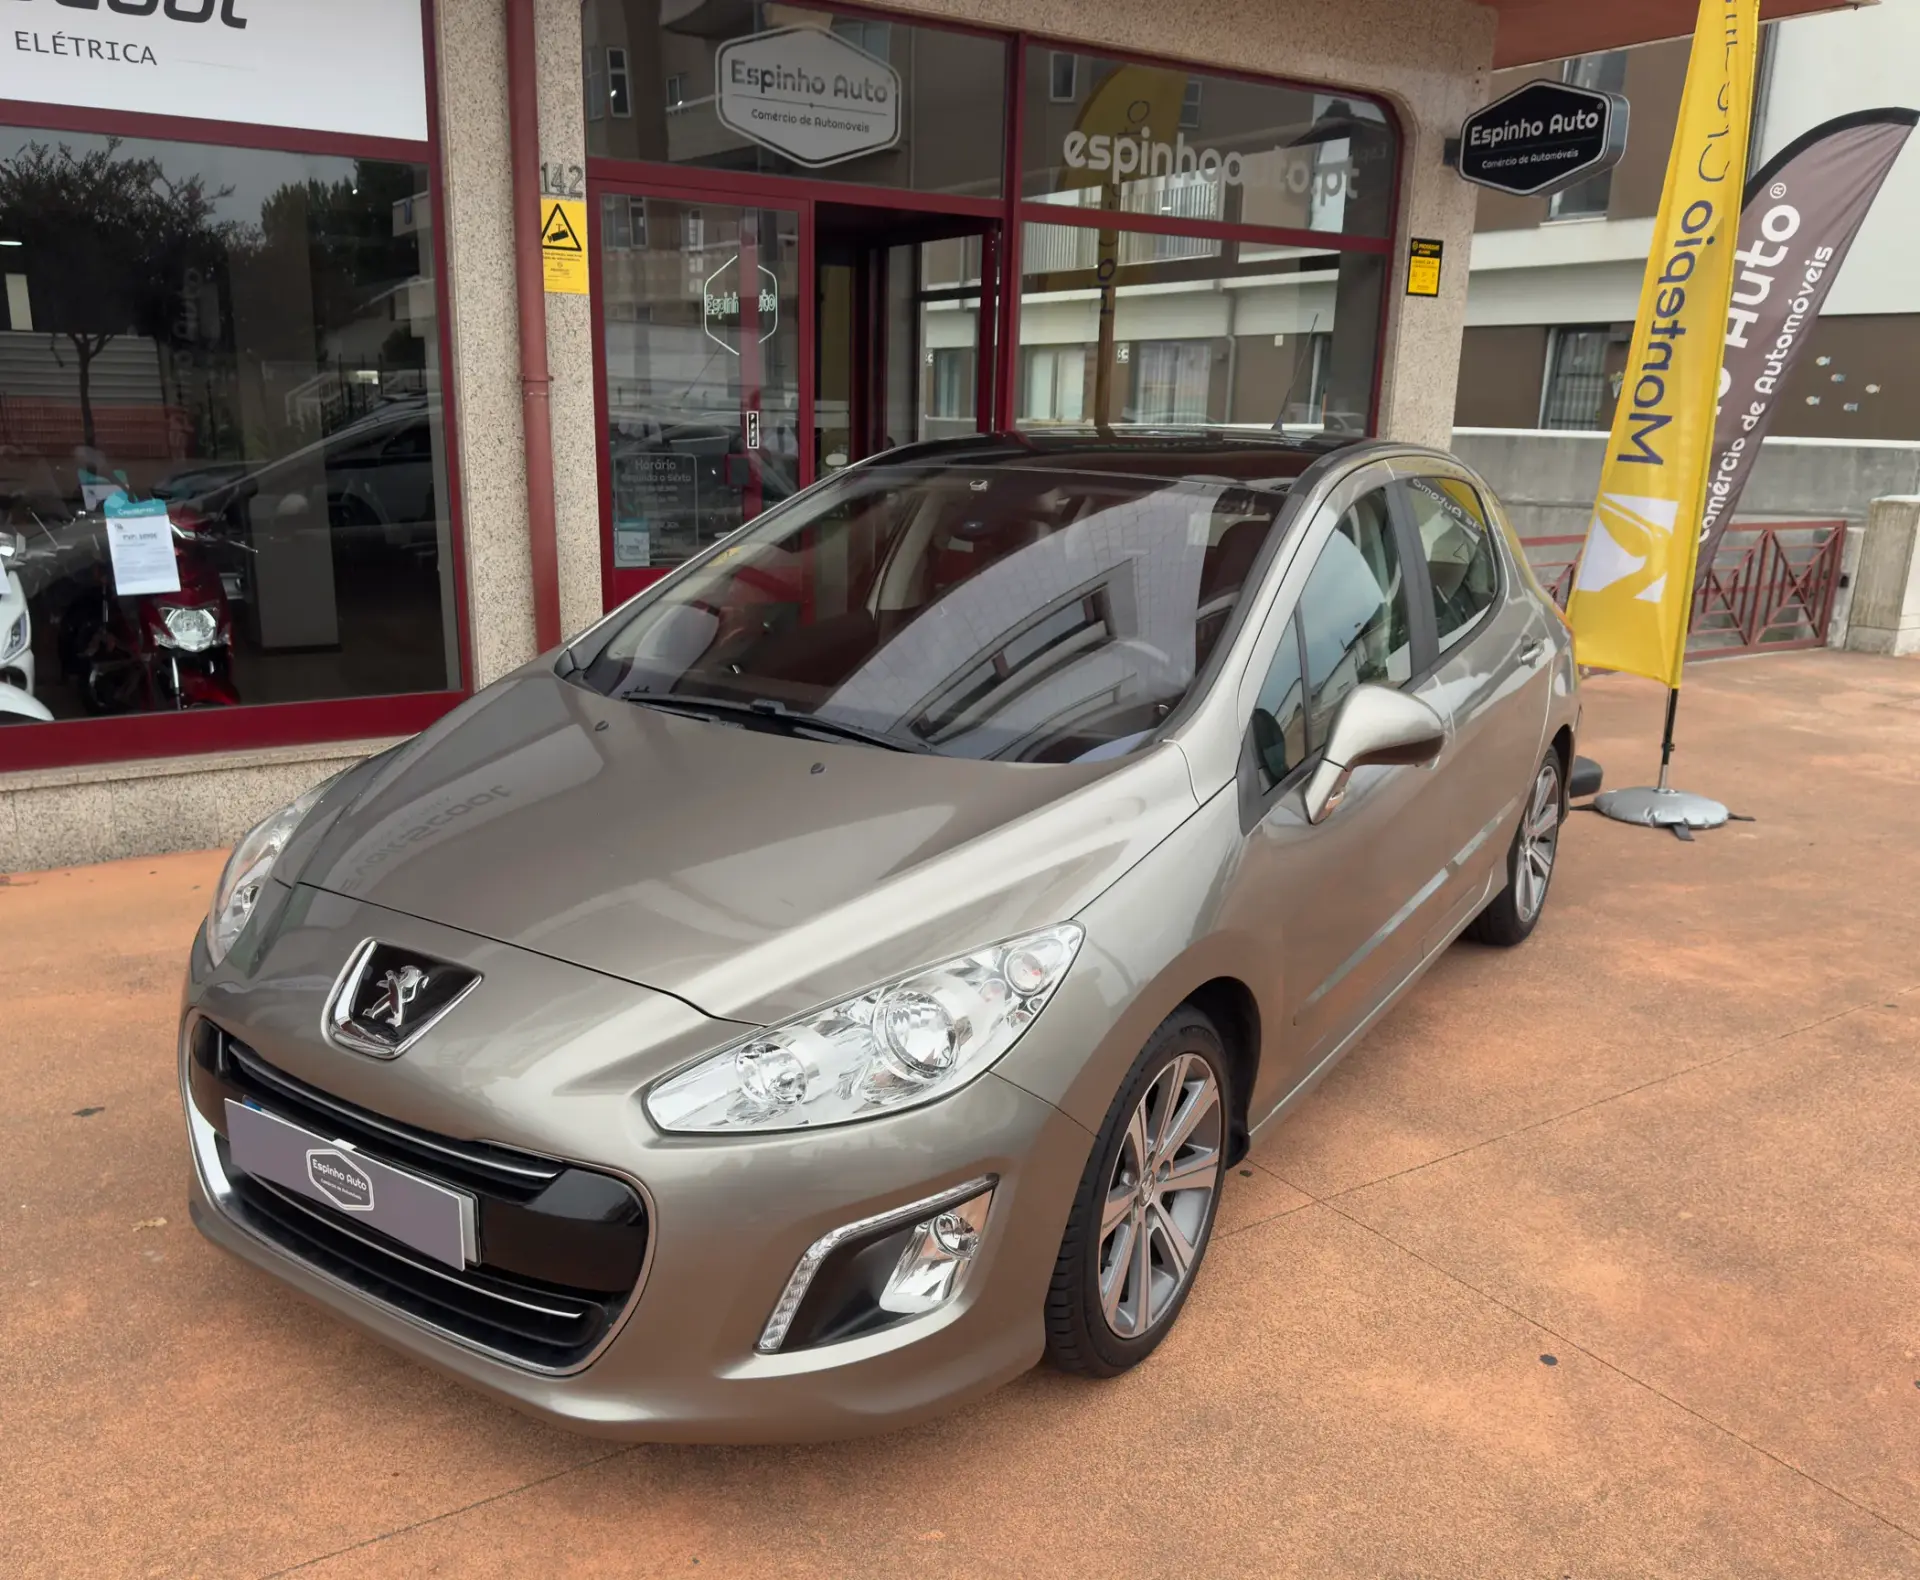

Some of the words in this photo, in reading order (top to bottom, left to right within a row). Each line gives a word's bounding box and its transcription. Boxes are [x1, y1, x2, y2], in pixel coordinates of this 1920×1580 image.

[15, 30, 158, 66] ELÉTRICA
[730, 59, 826, 94] Espinho
[833, 73, 888, 103] Auto
[751, 108, 797, 124] Comércio
[800, 114, 812, 125] de
[1470, 118, 1544, 148] Espinho
[1549, 109, 1599, 134] Auto
[1482, 155, 1517, 169] Comércio
[1519, 153, 1529, 164] de
[1530, 148, 1579, 162] Automóveis
[541, 162, 583, 196] 142
[1741, 401, 1766, 431] de
[1754, 245, 1833, 395] Automóveis
[312, 1158, 345, 1180] Espinho
[346, 1174, 367, 1190] Auto
